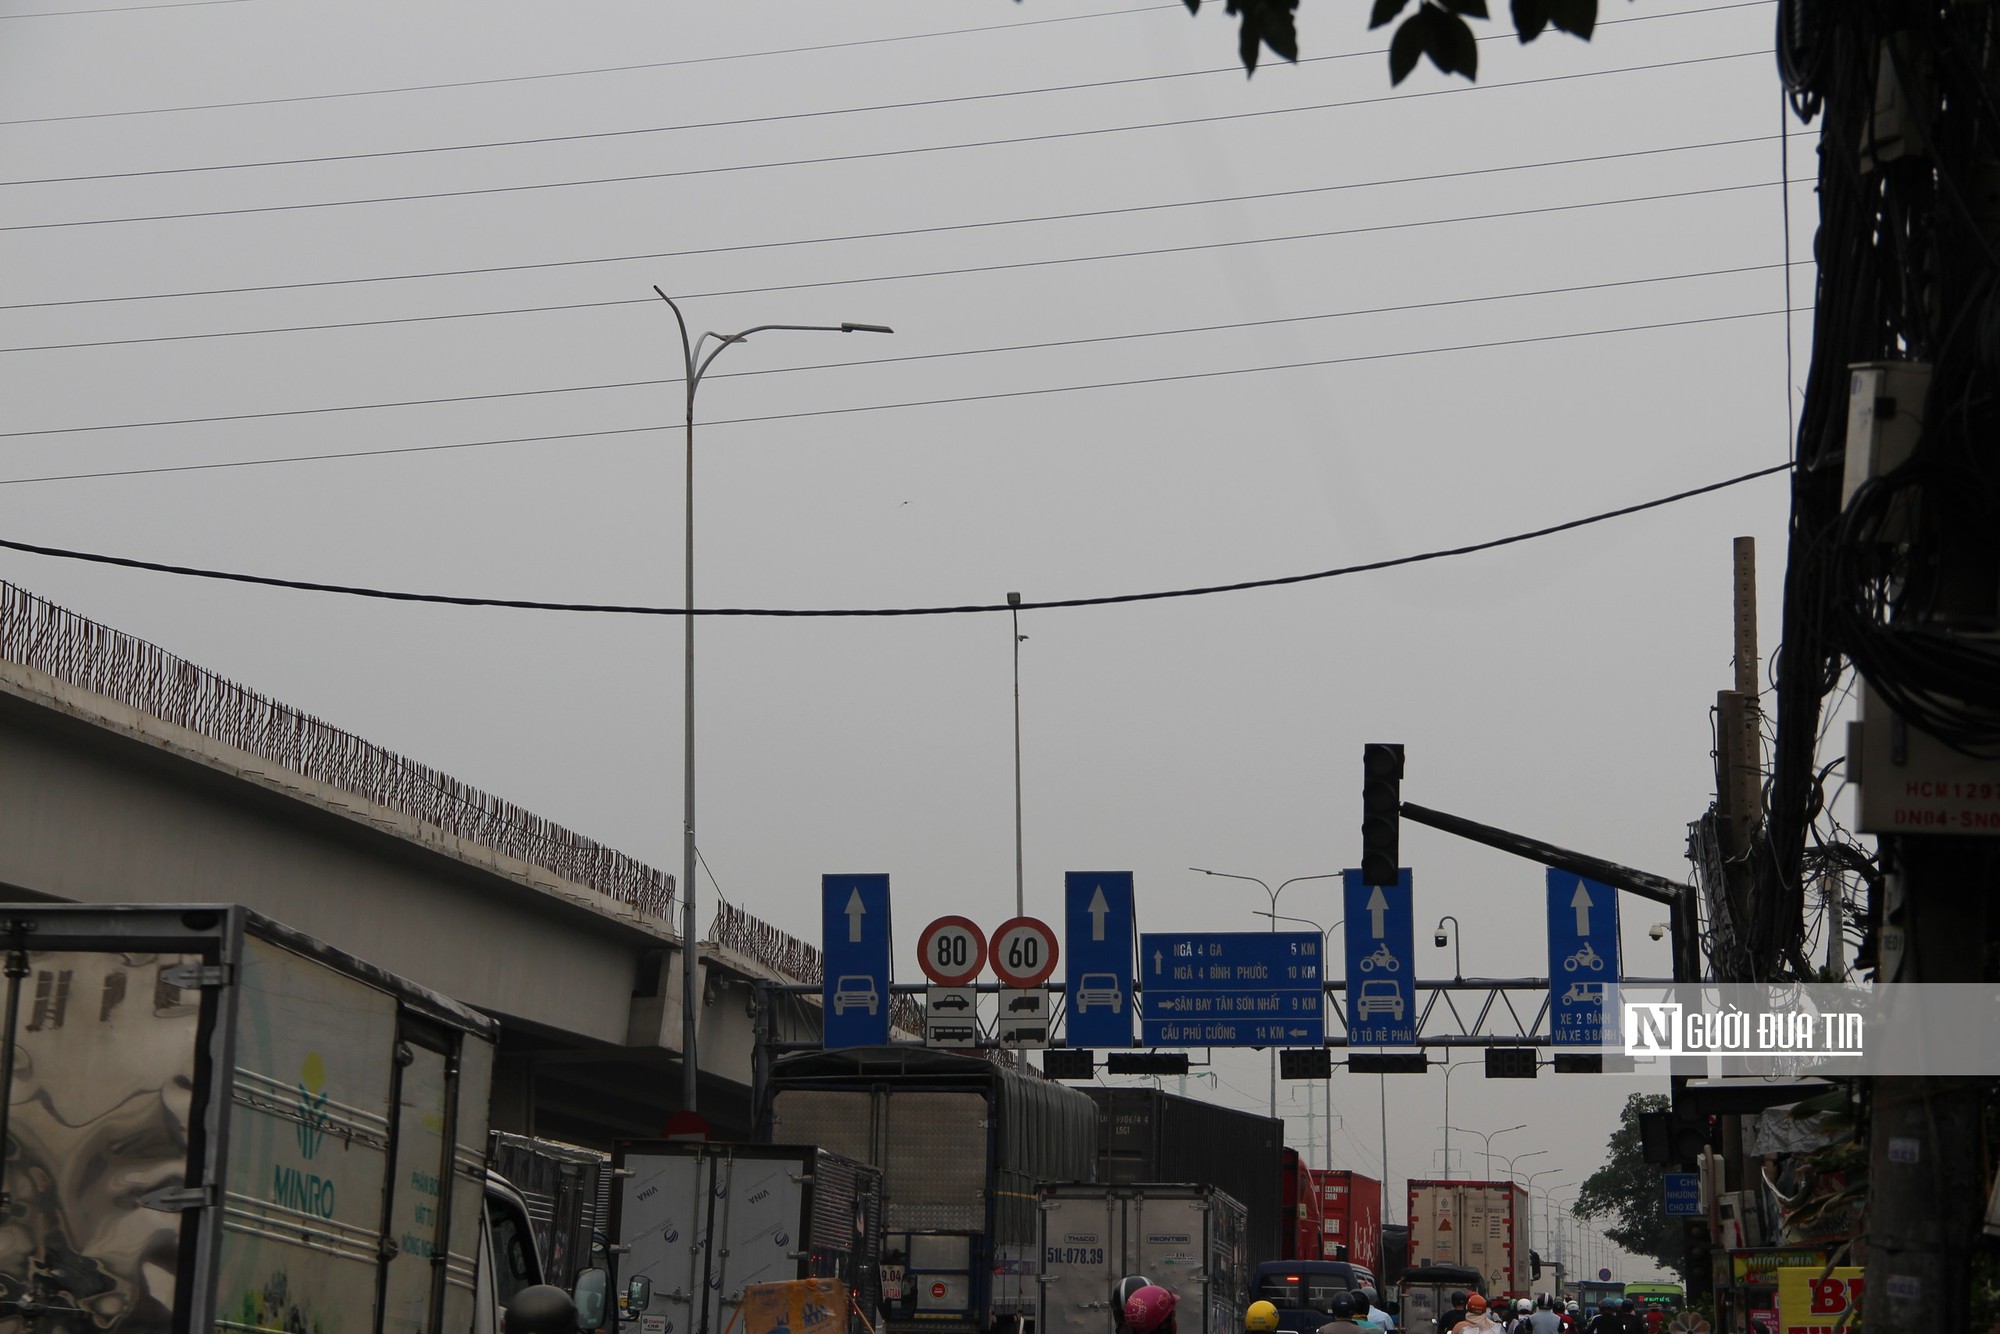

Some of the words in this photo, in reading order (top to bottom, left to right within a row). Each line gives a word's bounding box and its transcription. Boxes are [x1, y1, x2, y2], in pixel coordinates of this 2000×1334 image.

[938, 935, 967, 966] 80
[1009, 937, 1037, 968] 60
[1173, 942, 1193, 957] NGÃ
[1197, 944, 1204, 956] 4
[1209, 944, 1222, 956] GA
[1291, 943, 1297, 956] 5
[1301, 944, 1316, 956] KM
[1174, 964, 1193, 980] NGÃ
[1198, 967, 1204, 979] 4
[1287, 966, 1297, 979] 10
[1301, 966, 1316, 979] KM
[1174, 995, 1193, 1011] SÂN
[1196, 998, 1212, 1011] BAY
[1215, 995, 1233, 1011] TÂN
[1236, 997, 1254, 1011] SƠN
[1257, 992, 1280, 1011] NHẤT
[1292, 997, 1297, 1011] 9
[1302, 997, 1317, 1010] KM
[1560, 1013, 1573, 1025] XE
[1576, 1012, 1582, 1025] 2
[1183, 1024, 1201, 1040] PHÚ
[1205, 1023, 1236, 1040] CƯỜNG
[1255, 1027, 1265, 1040] 14
[1270, 1027, 1285, 1040] KM
[1351, 1027, 1358, 1043] Ô
[1360, 1027, 1373, 1043] TÔ
[1569, 1029, 1581, 1041] XE
[1584, 1029, 1591, 1041] 3
[274, 1164, 335, 1219] MINRO
[637, 1186, 659, 1202] VINA
[748, 1189, 771, 1205] VINA
[1047, 1248, 1103, 1265] 51L-078.39
